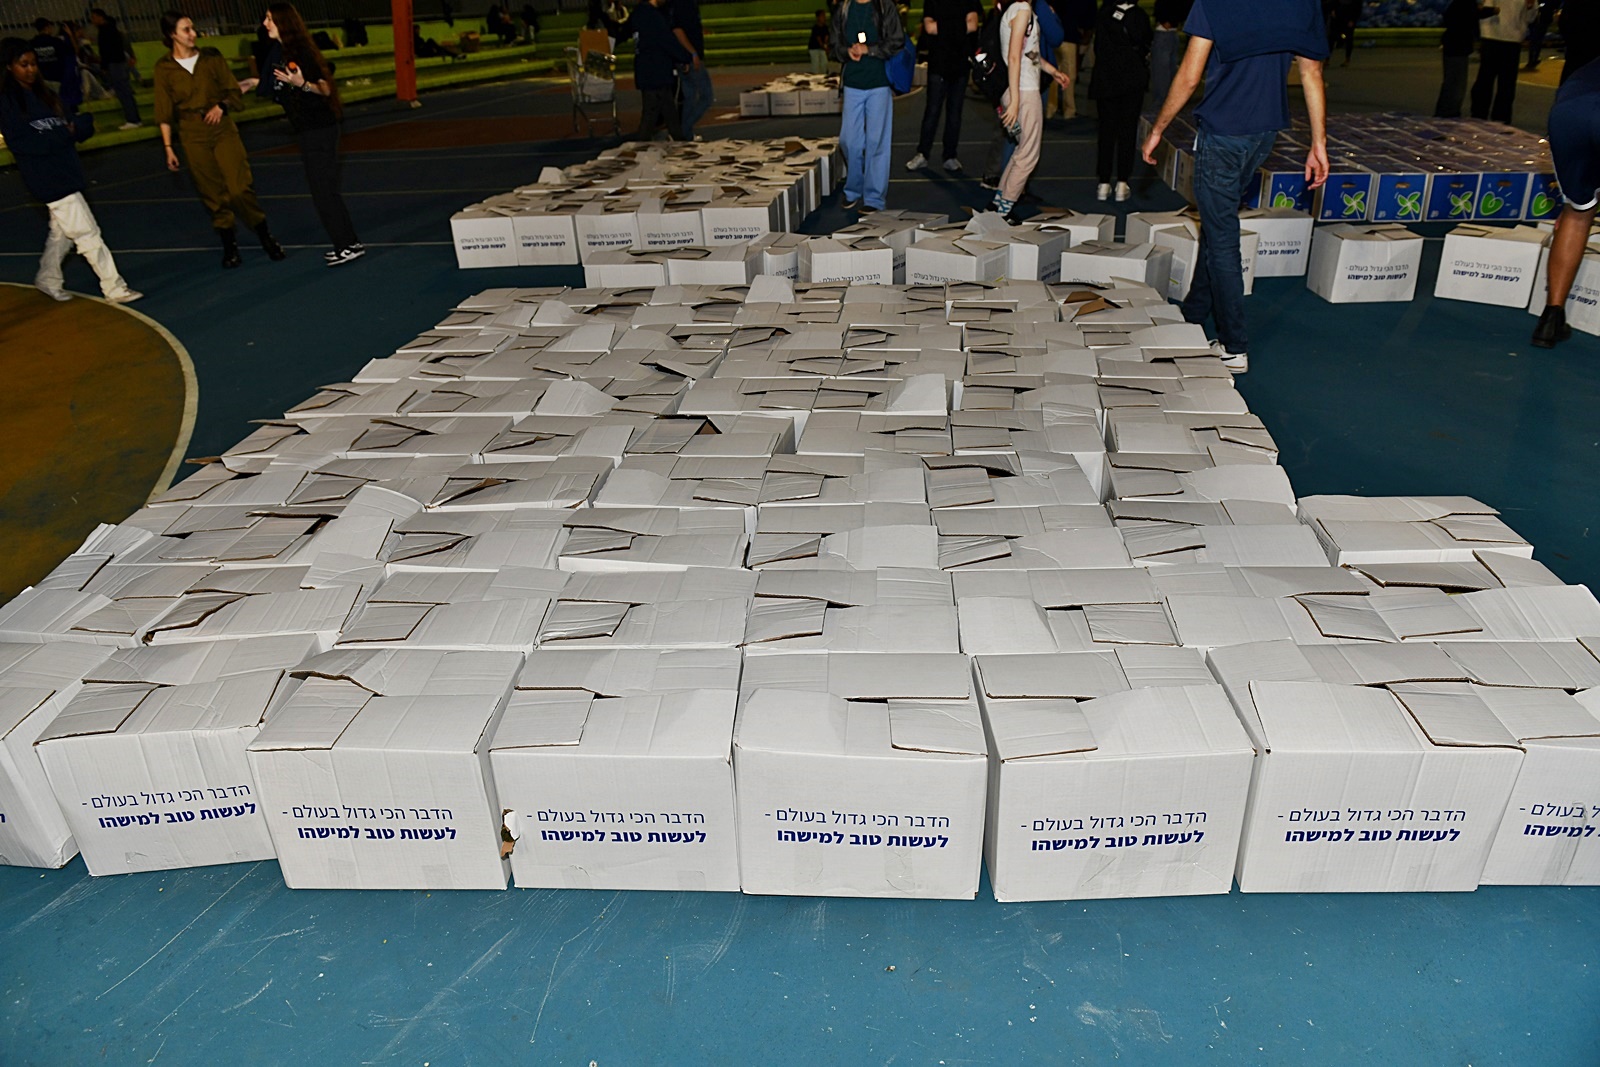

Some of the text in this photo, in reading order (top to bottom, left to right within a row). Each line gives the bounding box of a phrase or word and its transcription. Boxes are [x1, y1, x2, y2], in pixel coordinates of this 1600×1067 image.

[1453, 269, 1520, 282] לעשות טוב למישהו
[140, 792, 175, 805] גדול
[178, 790, 204, 801] הכי
[207, 785, 250, 799] הדבר
[91, 794, 139, 808] בעולם
[98, 802, 255, 828] לעשות טוב למישהו
[292, 804, 340, 818] בעולם
[342, 805, 376, 819] גדול
[380, 809, 405, 819] הכי
[409, 809, 453, 820] הדבר
[537, 809, 586, 822] בעולם
[590, 810, 624, 823] גדול
[777, 808, 826, 823] בעולם
[1289, 808, 1340, 821] בעולם
[1348, 808, 1381, 821] גדול
[1388, 810, 1414, 821] הכי
[1421, 810, 1465, 821] הדבר
[1531, 803, 1585, 817] בעולם
[630, 813, 655, 823] הכי
[660, 813, 704, 823] הדבר
[832, 811, 866, 825] גדול
[873, 815, 898, 826] הכי
[904, 816, 949, 827] הדבר
[1033, 818, 1083, 831] בעולם
[1090, 816, 1123, 829] גדול
[1131, 815, 1156, 826] הכי
[1162, 812, 1206, 826] הדבר
[298, 826, 456, 840] לעשות טוב למישהו
[541, 830, 706, 843] לעשות טוב למישהו
[1285, 829, 1460, 842] לעשות טוב למישהו
[1523, 824, 1596, 837] למישהו
[778, 830, 948, 848] לעשות טוב למישהו
[1032, 830, 1204, 851] לעשות טוב למישהו
